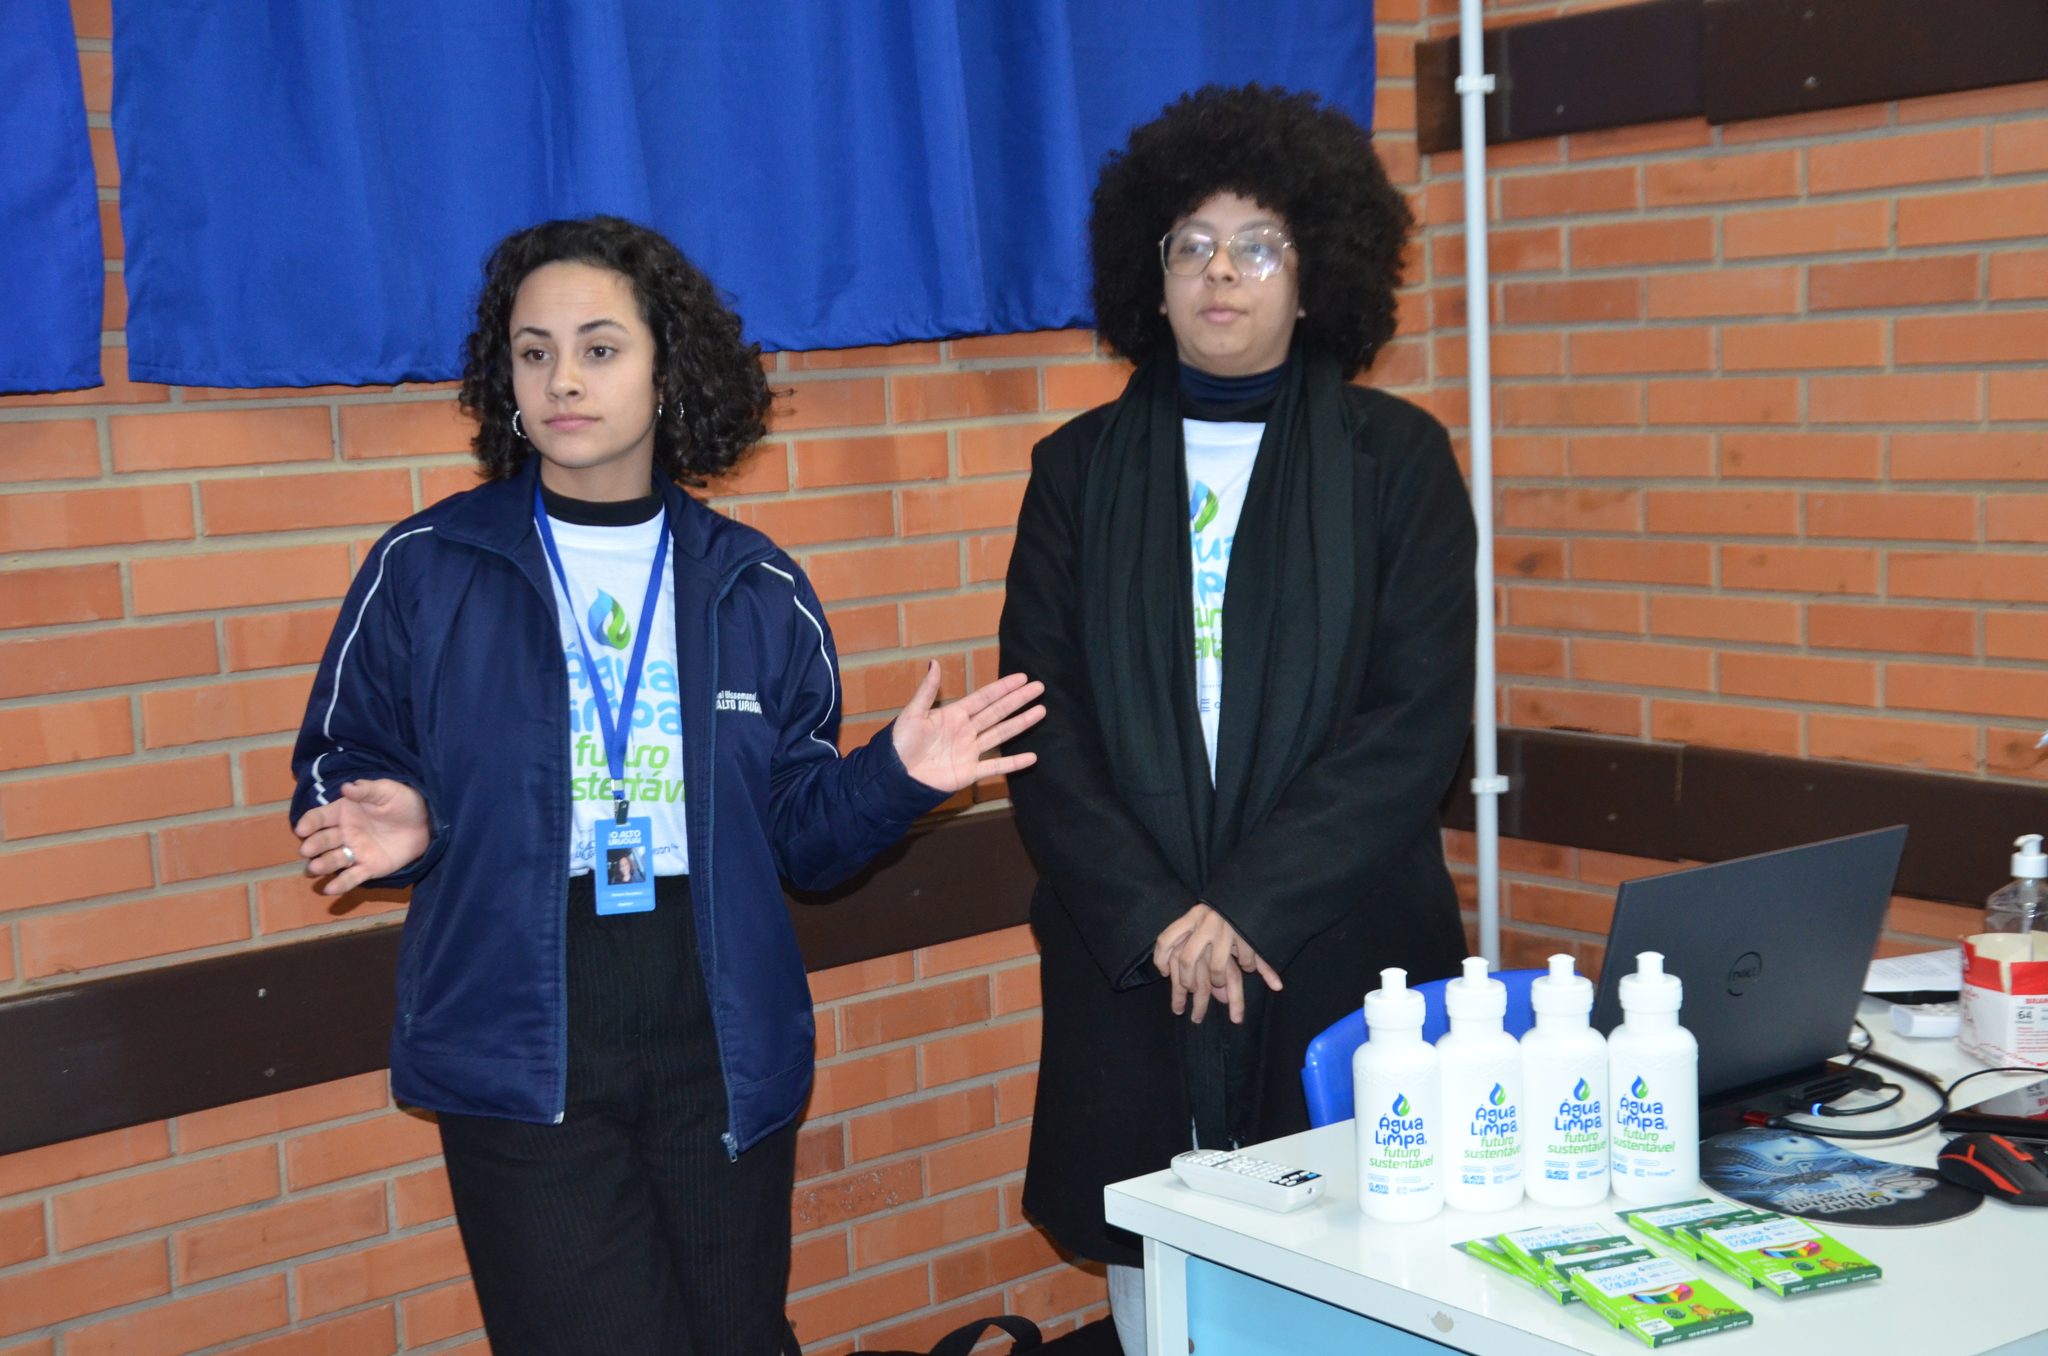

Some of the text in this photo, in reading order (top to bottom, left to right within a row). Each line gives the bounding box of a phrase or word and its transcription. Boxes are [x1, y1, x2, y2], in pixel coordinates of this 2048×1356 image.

[716, 699, 736, 710] ALTO
[576, 734, 670, 769] fuuro
[1475, 1103, 1516, 1124] Água
[1559, 1098, 1601, 1119] Água
[1620, 1093, 1663, 1116] Água
[1379, 1112, 1424, 1135] Água
[1623, 1126, 1659, 1142] futuro
[1383, 1146, 1421, 1159] futuro
